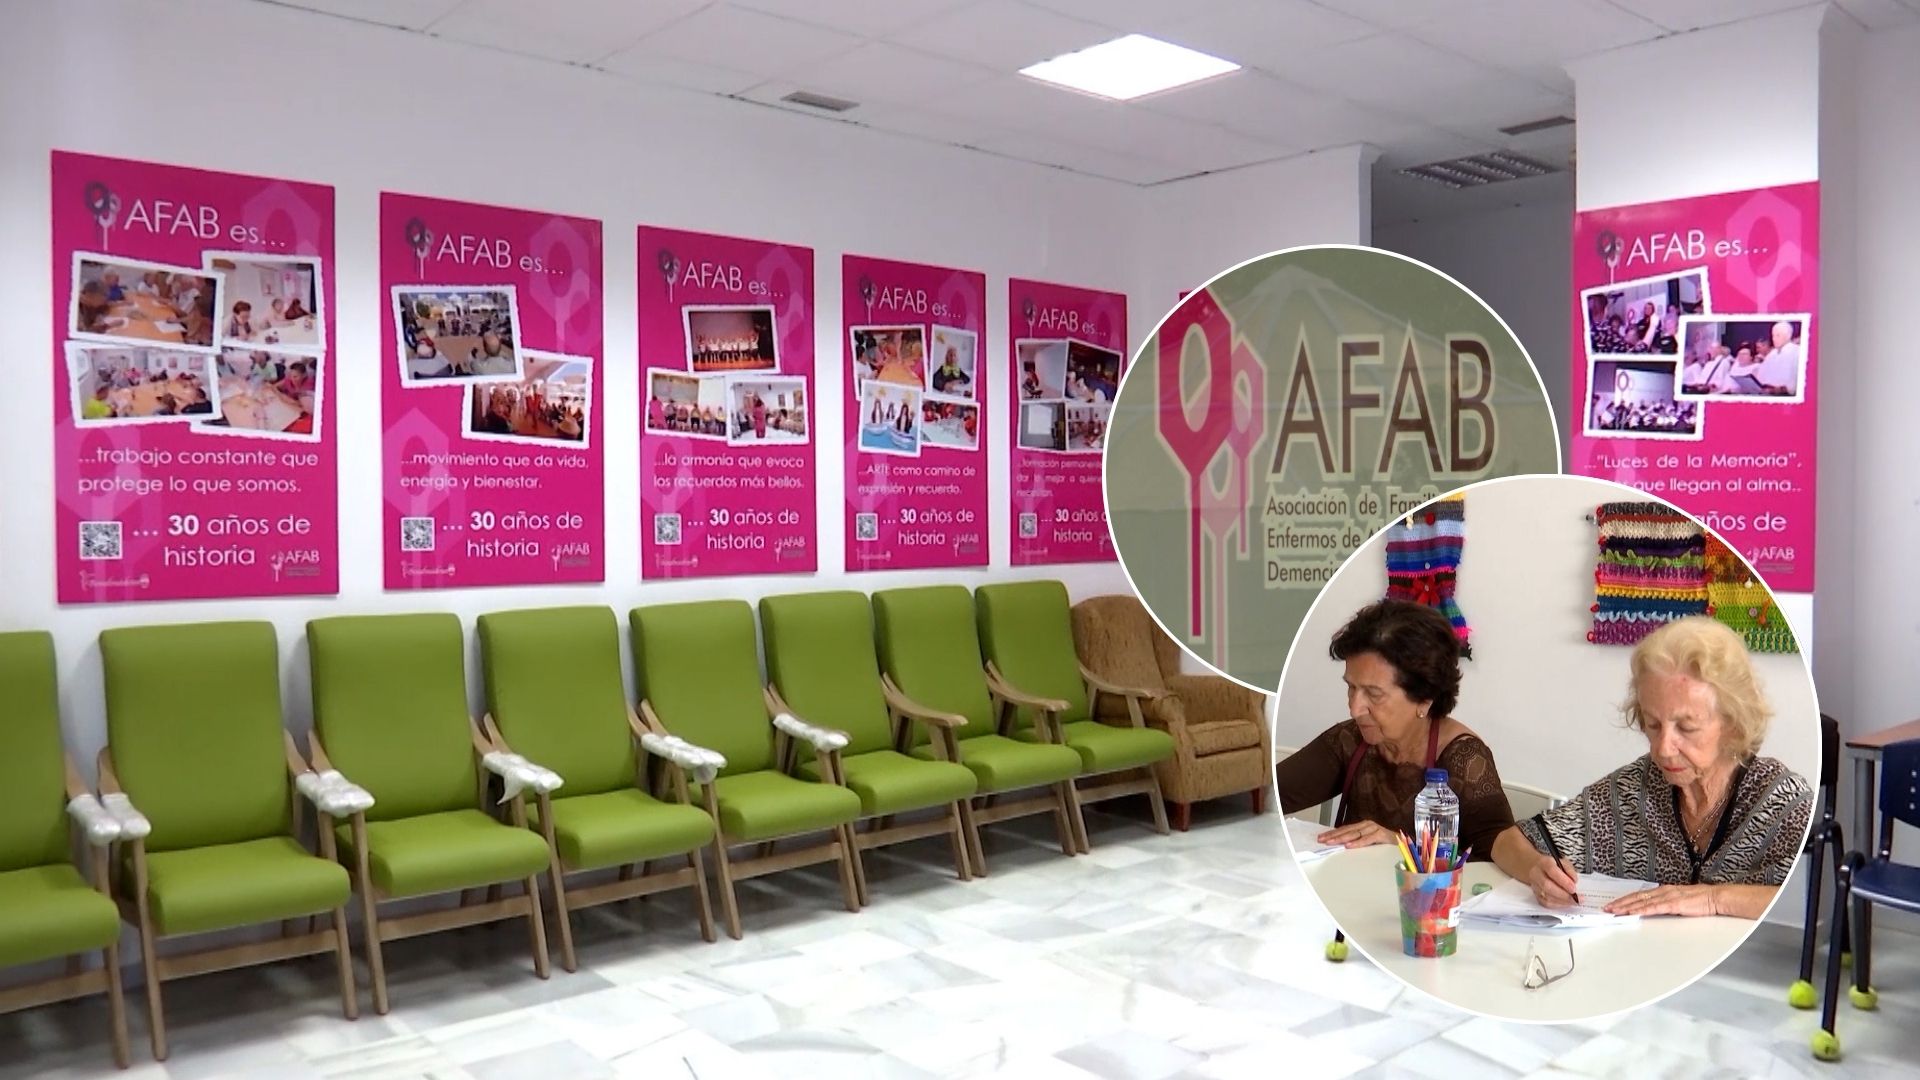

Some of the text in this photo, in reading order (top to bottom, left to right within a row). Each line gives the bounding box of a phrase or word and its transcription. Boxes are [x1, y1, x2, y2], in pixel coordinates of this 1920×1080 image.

[124, 199, 286, 248] AFAB es...
[437, 234, 564, 275] AFAB es...
[1626, 229, 1768, 267] AFAB es...
[683, 261, 784, 297] AFAB es...
[879, 286, 961, 319] AFAB es...
[1038, 307, 1079, 332] AFAB
[1271, 337, 1495, 474] AFAB
[78, 448, 318, 468] ...trabajo constante que
[503, 455, 530, 470] que
[534, 454, 554, 468] da
[738, 455, 762, 470] que
[766, 455, 804, 468] evoca
[1656, 453, 1679, 469] de
[1687, 453, 1703, 469] la
[893, 465, 922, 477] como
[924, 465, 960, 477] camino
[962, 465, 976, 477] de
[78, 476, 302, 496] protege lo que somos.
[461, 477, 470, 490] y
[474, 476, 542, 489] bienestar.
[653, 475, 804, 489] los recuerdos más bellos.
[907, 484, 915, 496] y
[1670, 477, 1721, 495] llegan
[1726, 477, 1741, 492] al
[1746, 477, 1801, 493] alma..
[1267, 493, 1347, 516] Asociación
[1359, 492, 1378, 516] de
[470, 511, 495, 531] 30
[501, 510, 550, 530] años
[556, 511, 583, 529] de
[709, 508, 729, 526] 30
[734, 508, 774, 526] años
[777, 508, 800, 525] de
[900, 508, 917, 525] 30
[920, 508, 953, 523] años
[956, 508, 975, 523] de
[1055, 508, 1069, 522] 30
[1071, 508, 1099, 522] años
[1753, 511, 1788, 532] de
[168, 514, 200, 537] 30
[207, 514, 269, 536] años
[277, 514, 311, 535] de
[707, 532, 765, 550] historia
[898, 530, 946, 546] historia
[1053, 528, 1093, 543] historia
[1267, 528, 1337, 549] Enfermos
[1342, 527, 1361, 548] de
[164, 545, 256, 567] historia
[285, 550, 320, 563] AFAB
[467, 538, 540, 558] historia
[562, 543, 590, 556] AFAB
[1759, 548, 1795, 561] AFAB
